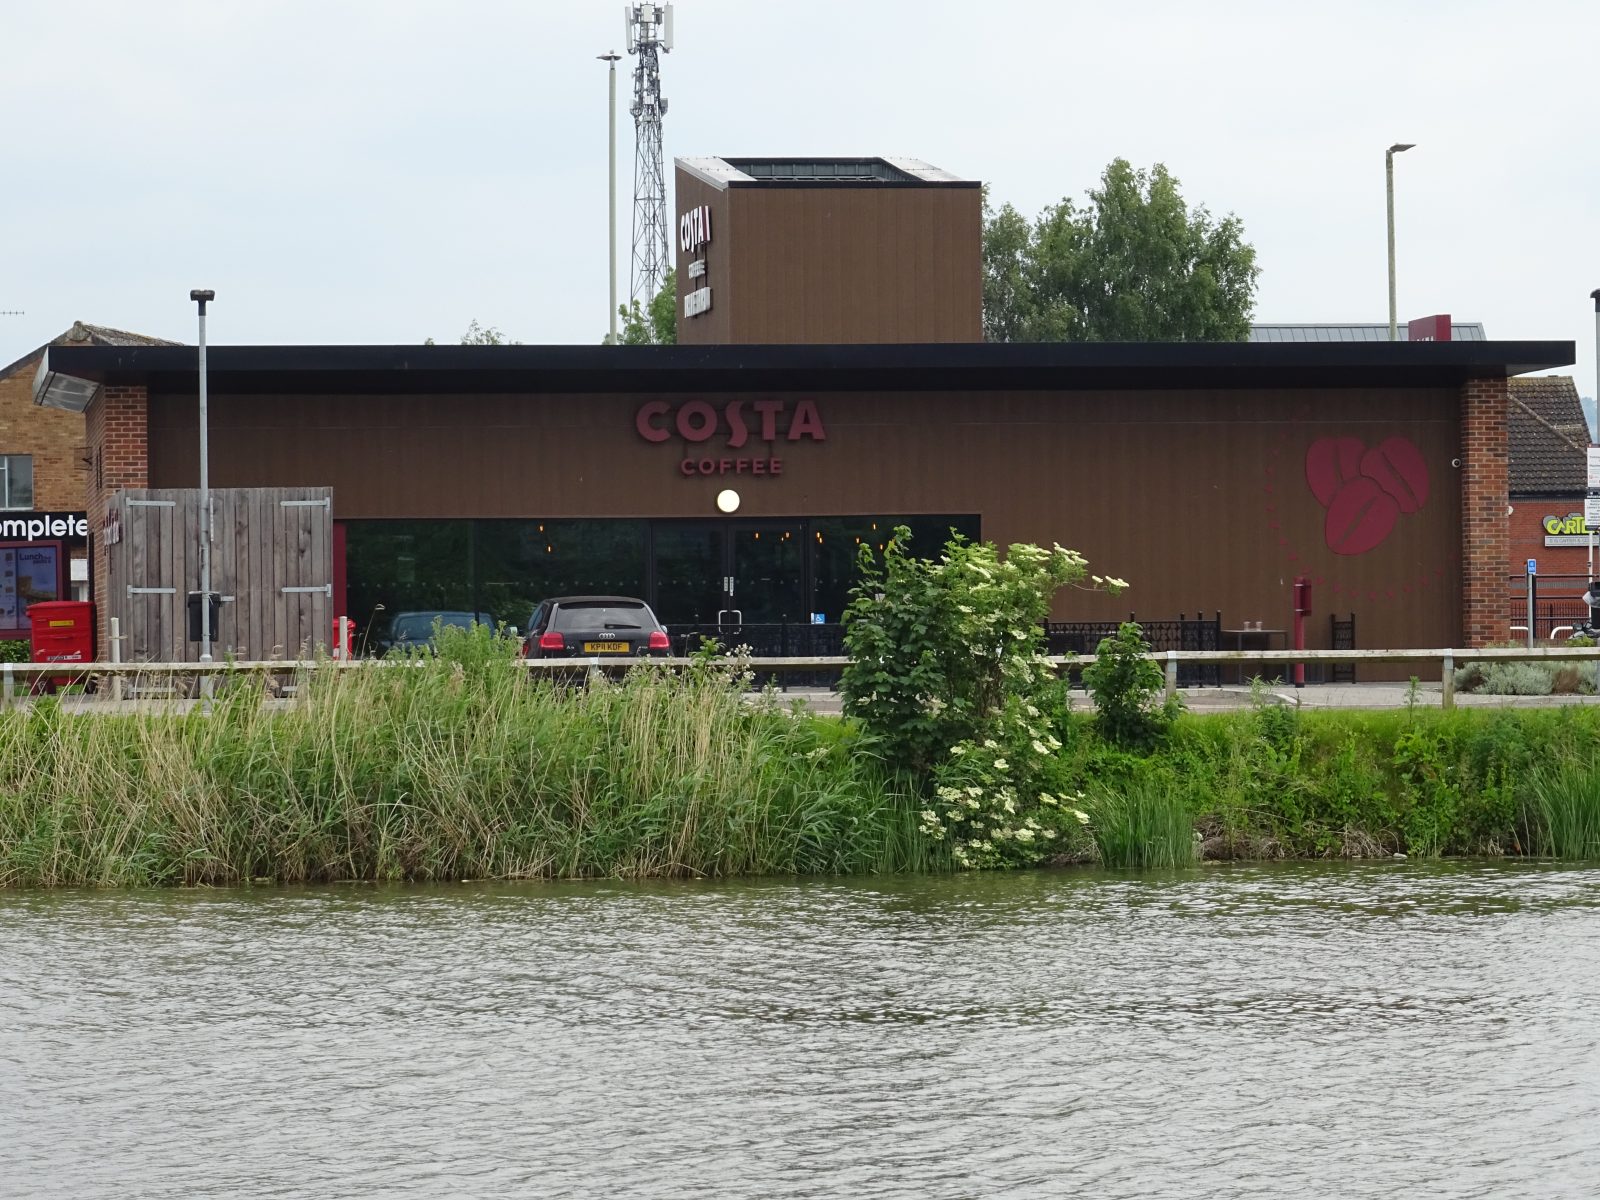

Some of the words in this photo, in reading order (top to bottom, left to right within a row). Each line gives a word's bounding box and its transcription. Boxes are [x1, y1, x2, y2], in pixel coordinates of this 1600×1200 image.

[681, 205, 710, 253] COSTA
[636, 400, 826, 448] COSTA
[681, 458, 783, 475] COFFEE
[0, 515, 87, 541] mplete
[19, 552, 43, 560] Lunch
